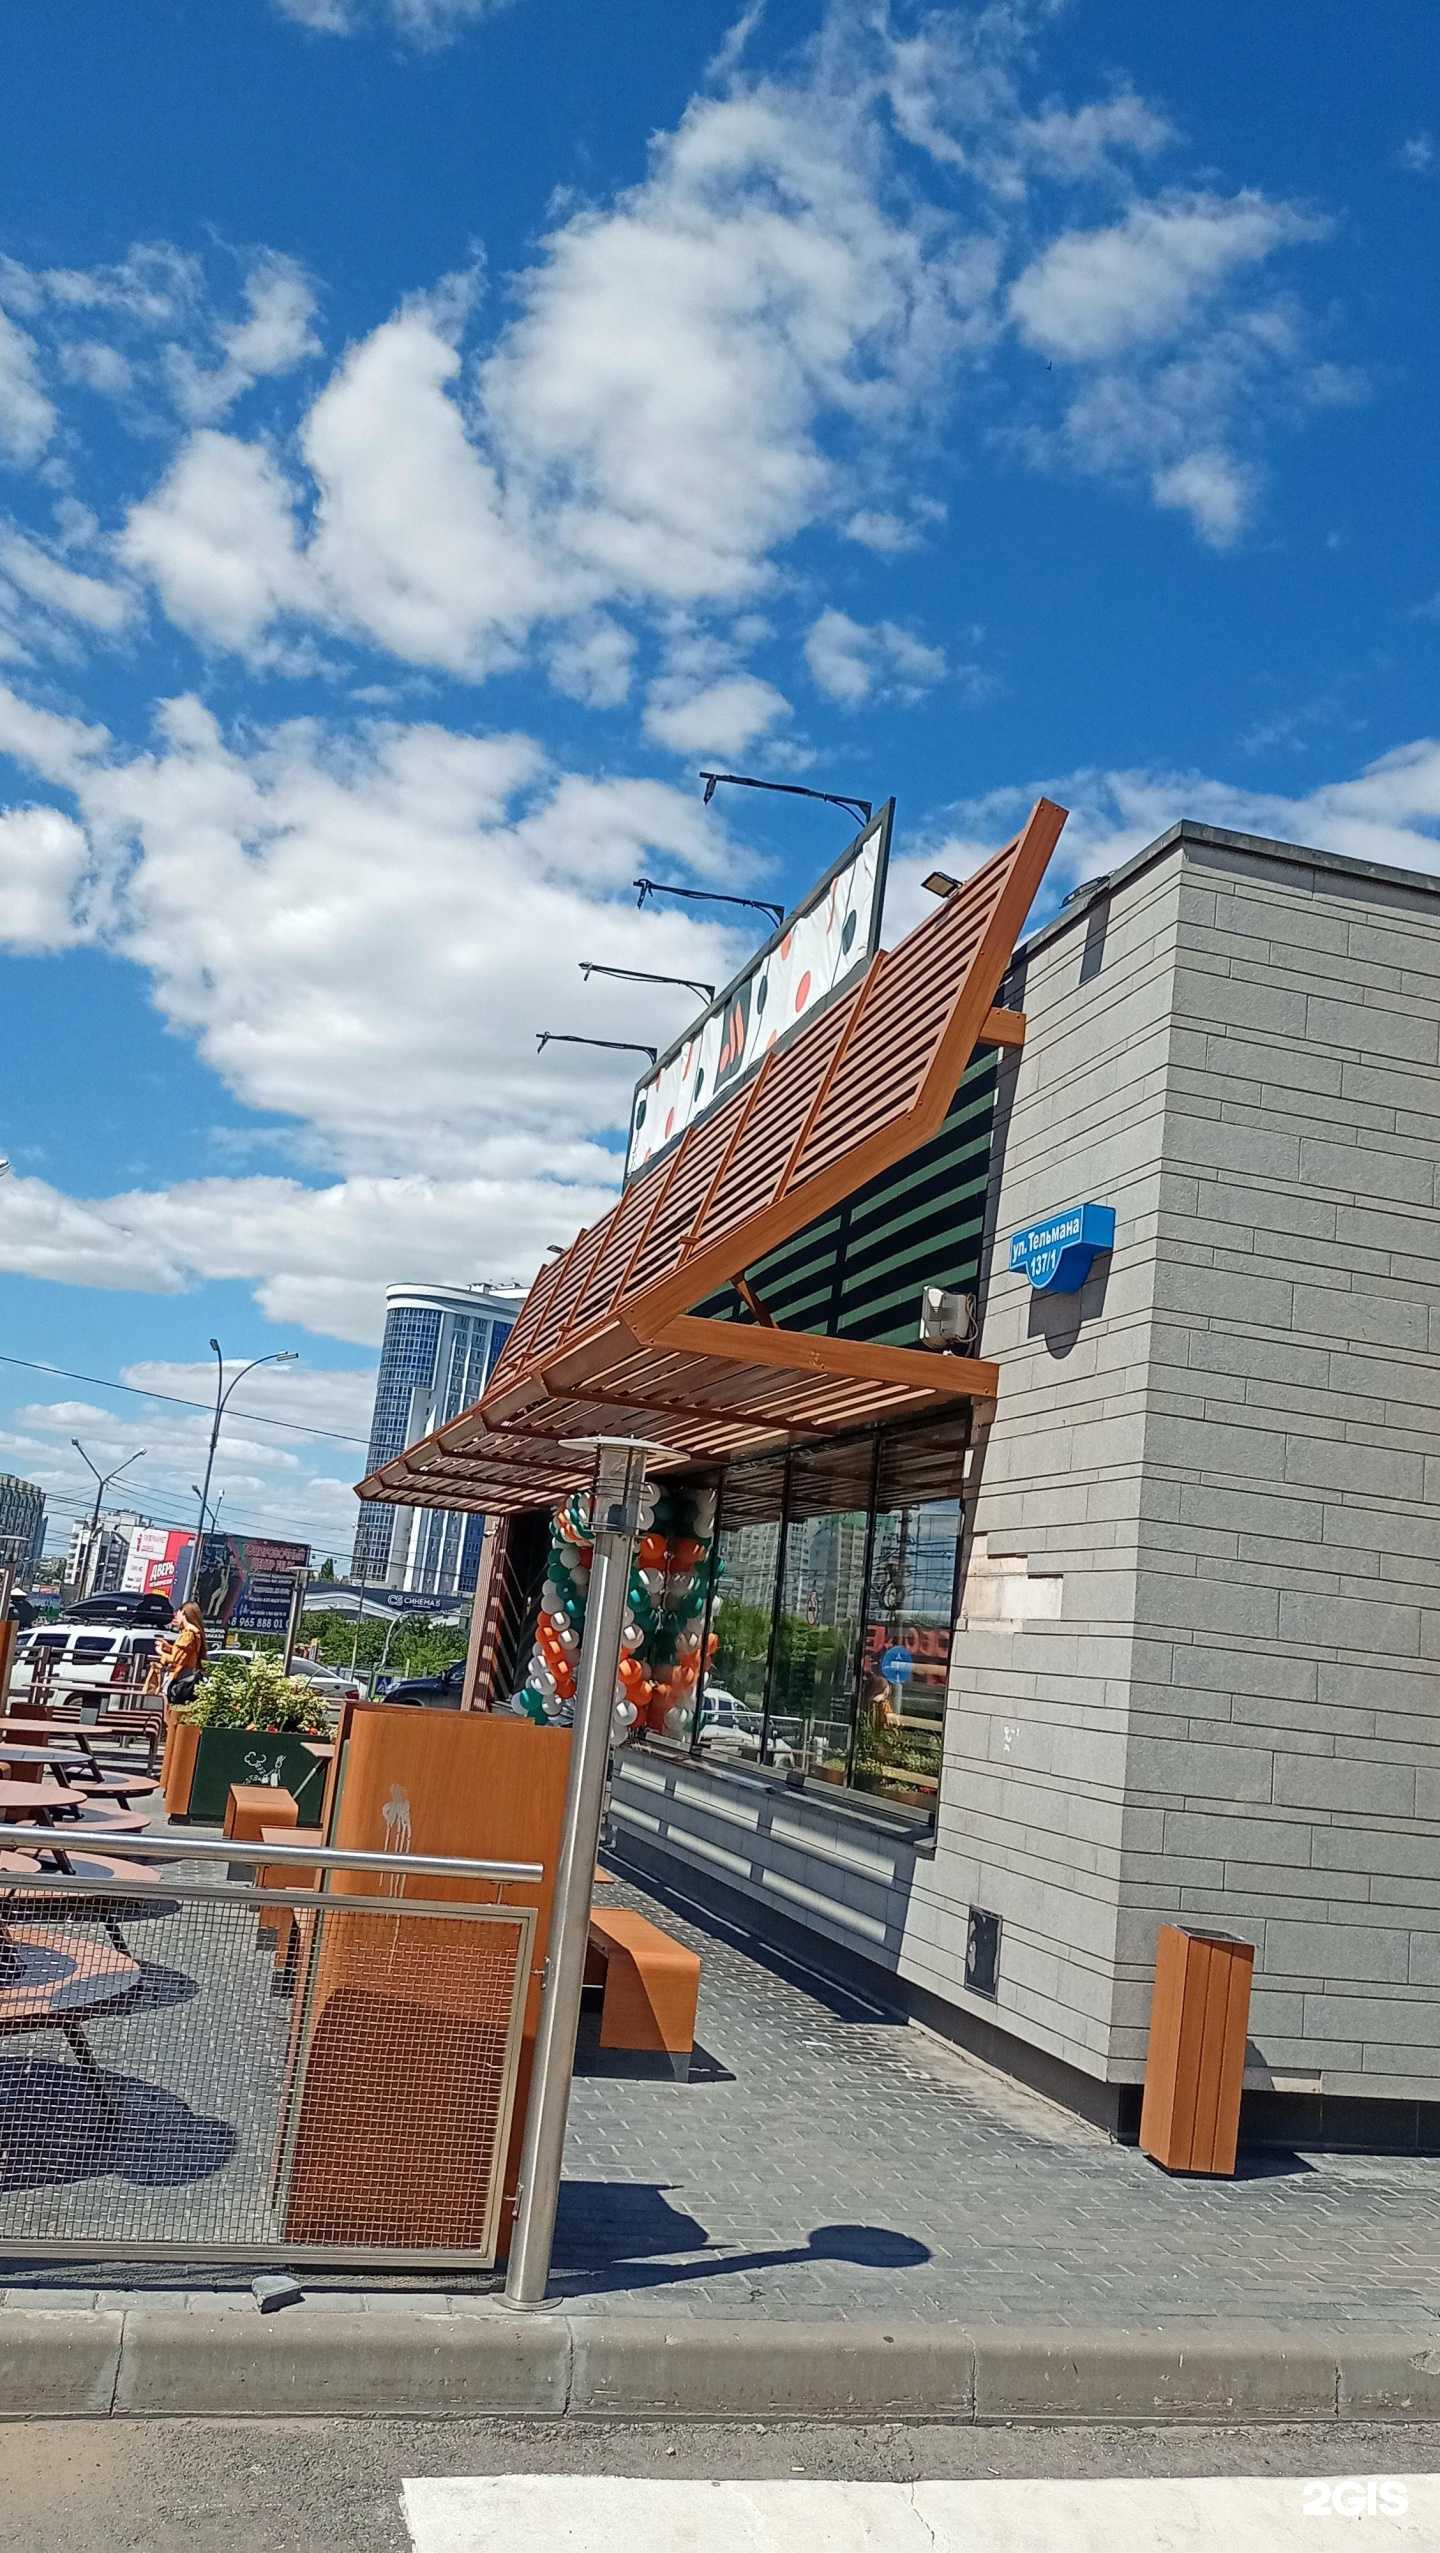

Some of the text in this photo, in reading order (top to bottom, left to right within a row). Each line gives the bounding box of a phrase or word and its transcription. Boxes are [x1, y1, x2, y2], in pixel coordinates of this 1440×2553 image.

[1012, 1218, 1080, 1263] ул. Тельмана
[1030, 1249, 1057, 1277] 137/1
[151, 1560, 174, 1581] ДВЕРЬ
[231, 1617, 237, 1626] 8
[239, 1617, 255, 1627] 965
[256, 1618, 272, 1628] 888
[273, 1619, 283, 1629] 01
